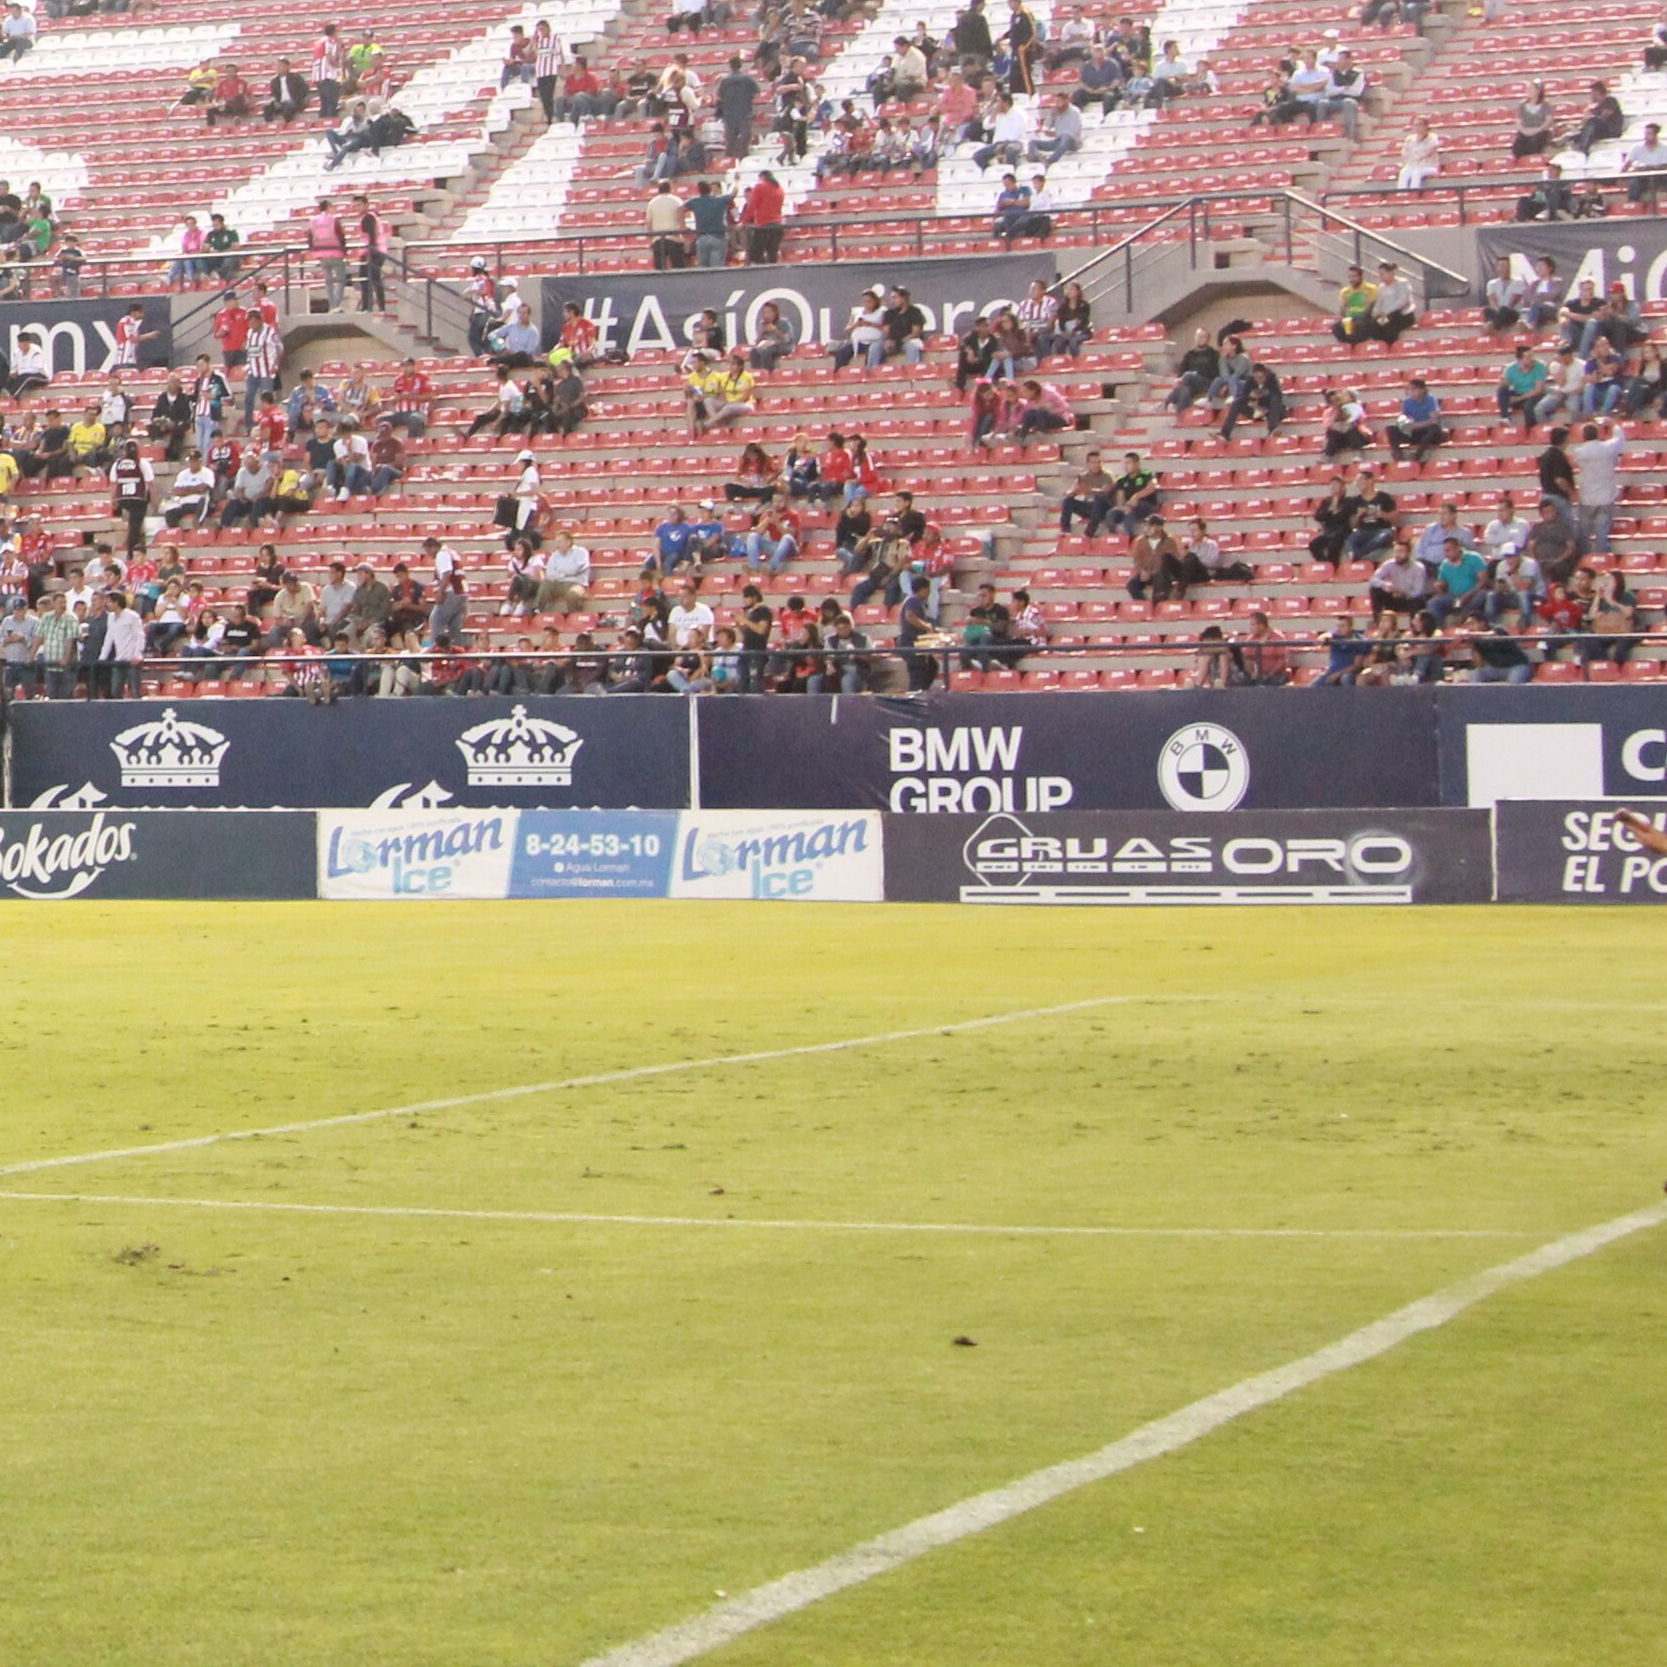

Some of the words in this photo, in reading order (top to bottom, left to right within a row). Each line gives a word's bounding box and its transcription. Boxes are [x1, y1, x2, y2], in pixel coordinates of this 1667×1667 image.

[888, 727, 1022, 772] BMW
[1170, 729, 1237, 756] BMW
[888, 777, 1073, 813] GROUP
[525, 834, 660, 856] 8-24-53-10
[975, 837, 1213, 873] GRUAS
[1222, 837, 1412, 875] ORO
[392, 856, 452, 894] Ice
[752, 859, 814, 899] Ice
[1562, 855, 1606, 892] EL
